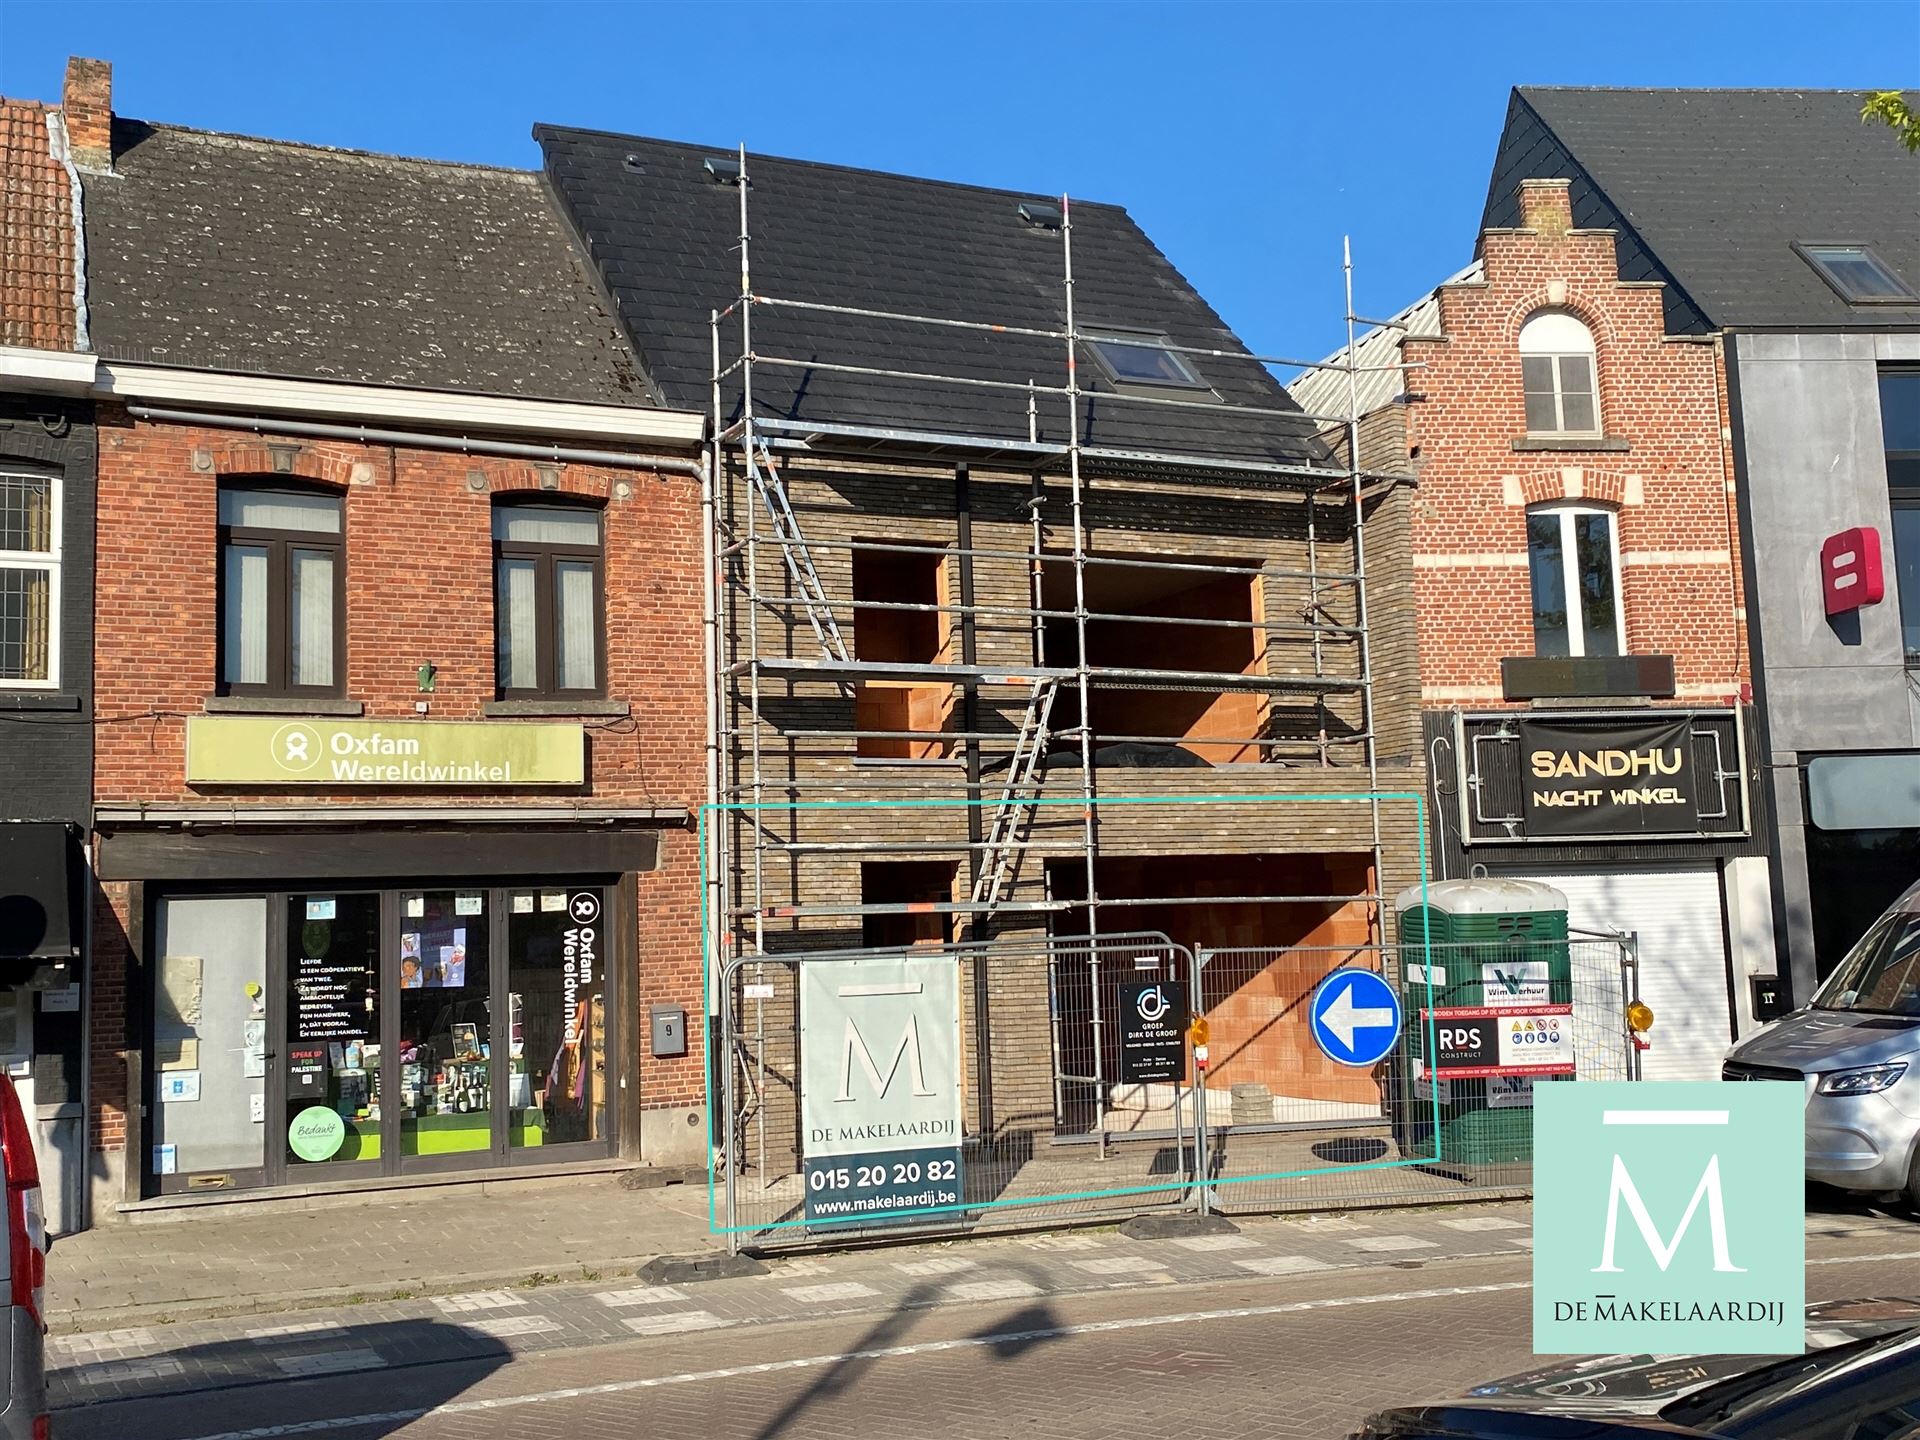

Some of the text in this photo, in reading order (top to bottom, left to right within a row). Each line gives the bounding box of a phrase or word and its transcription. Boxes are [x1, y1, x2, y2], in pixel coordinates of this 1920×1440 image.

[330, 732, 419, 755] Oxfam
[331, 759, 511, 782] Wereldwinkel
[1531, 748, 1683, 778] SANDHU
[1533, 787, 1687, 807] NACHT WINKEL
[580, 927, 595, 984] Oxfam
[563, 928, 579, 1044] Wereldwinkel
[1488, 988, 1508, 996] Wim
[666, 1024, 673, 1037] 9
[1142, 1022, 1164, 1030] GROEP
[1155, 1029, 1178, 1037] GROOF
[1439, 1028, 1482, 1050] RDS
[291, 1050, 323, 1059] SPEAK UP
[1440, 1051, 1482, 1059] CONSTRUCT
[291, 1065, 323, 1073] PALESTINE
[812, 1120, 954, 1143] DE MAKELAARDIJ
[810, 1160, 956, 1191] 015 20 20 82
[813, 1190, 957, 1215] www.makelaardij.be
